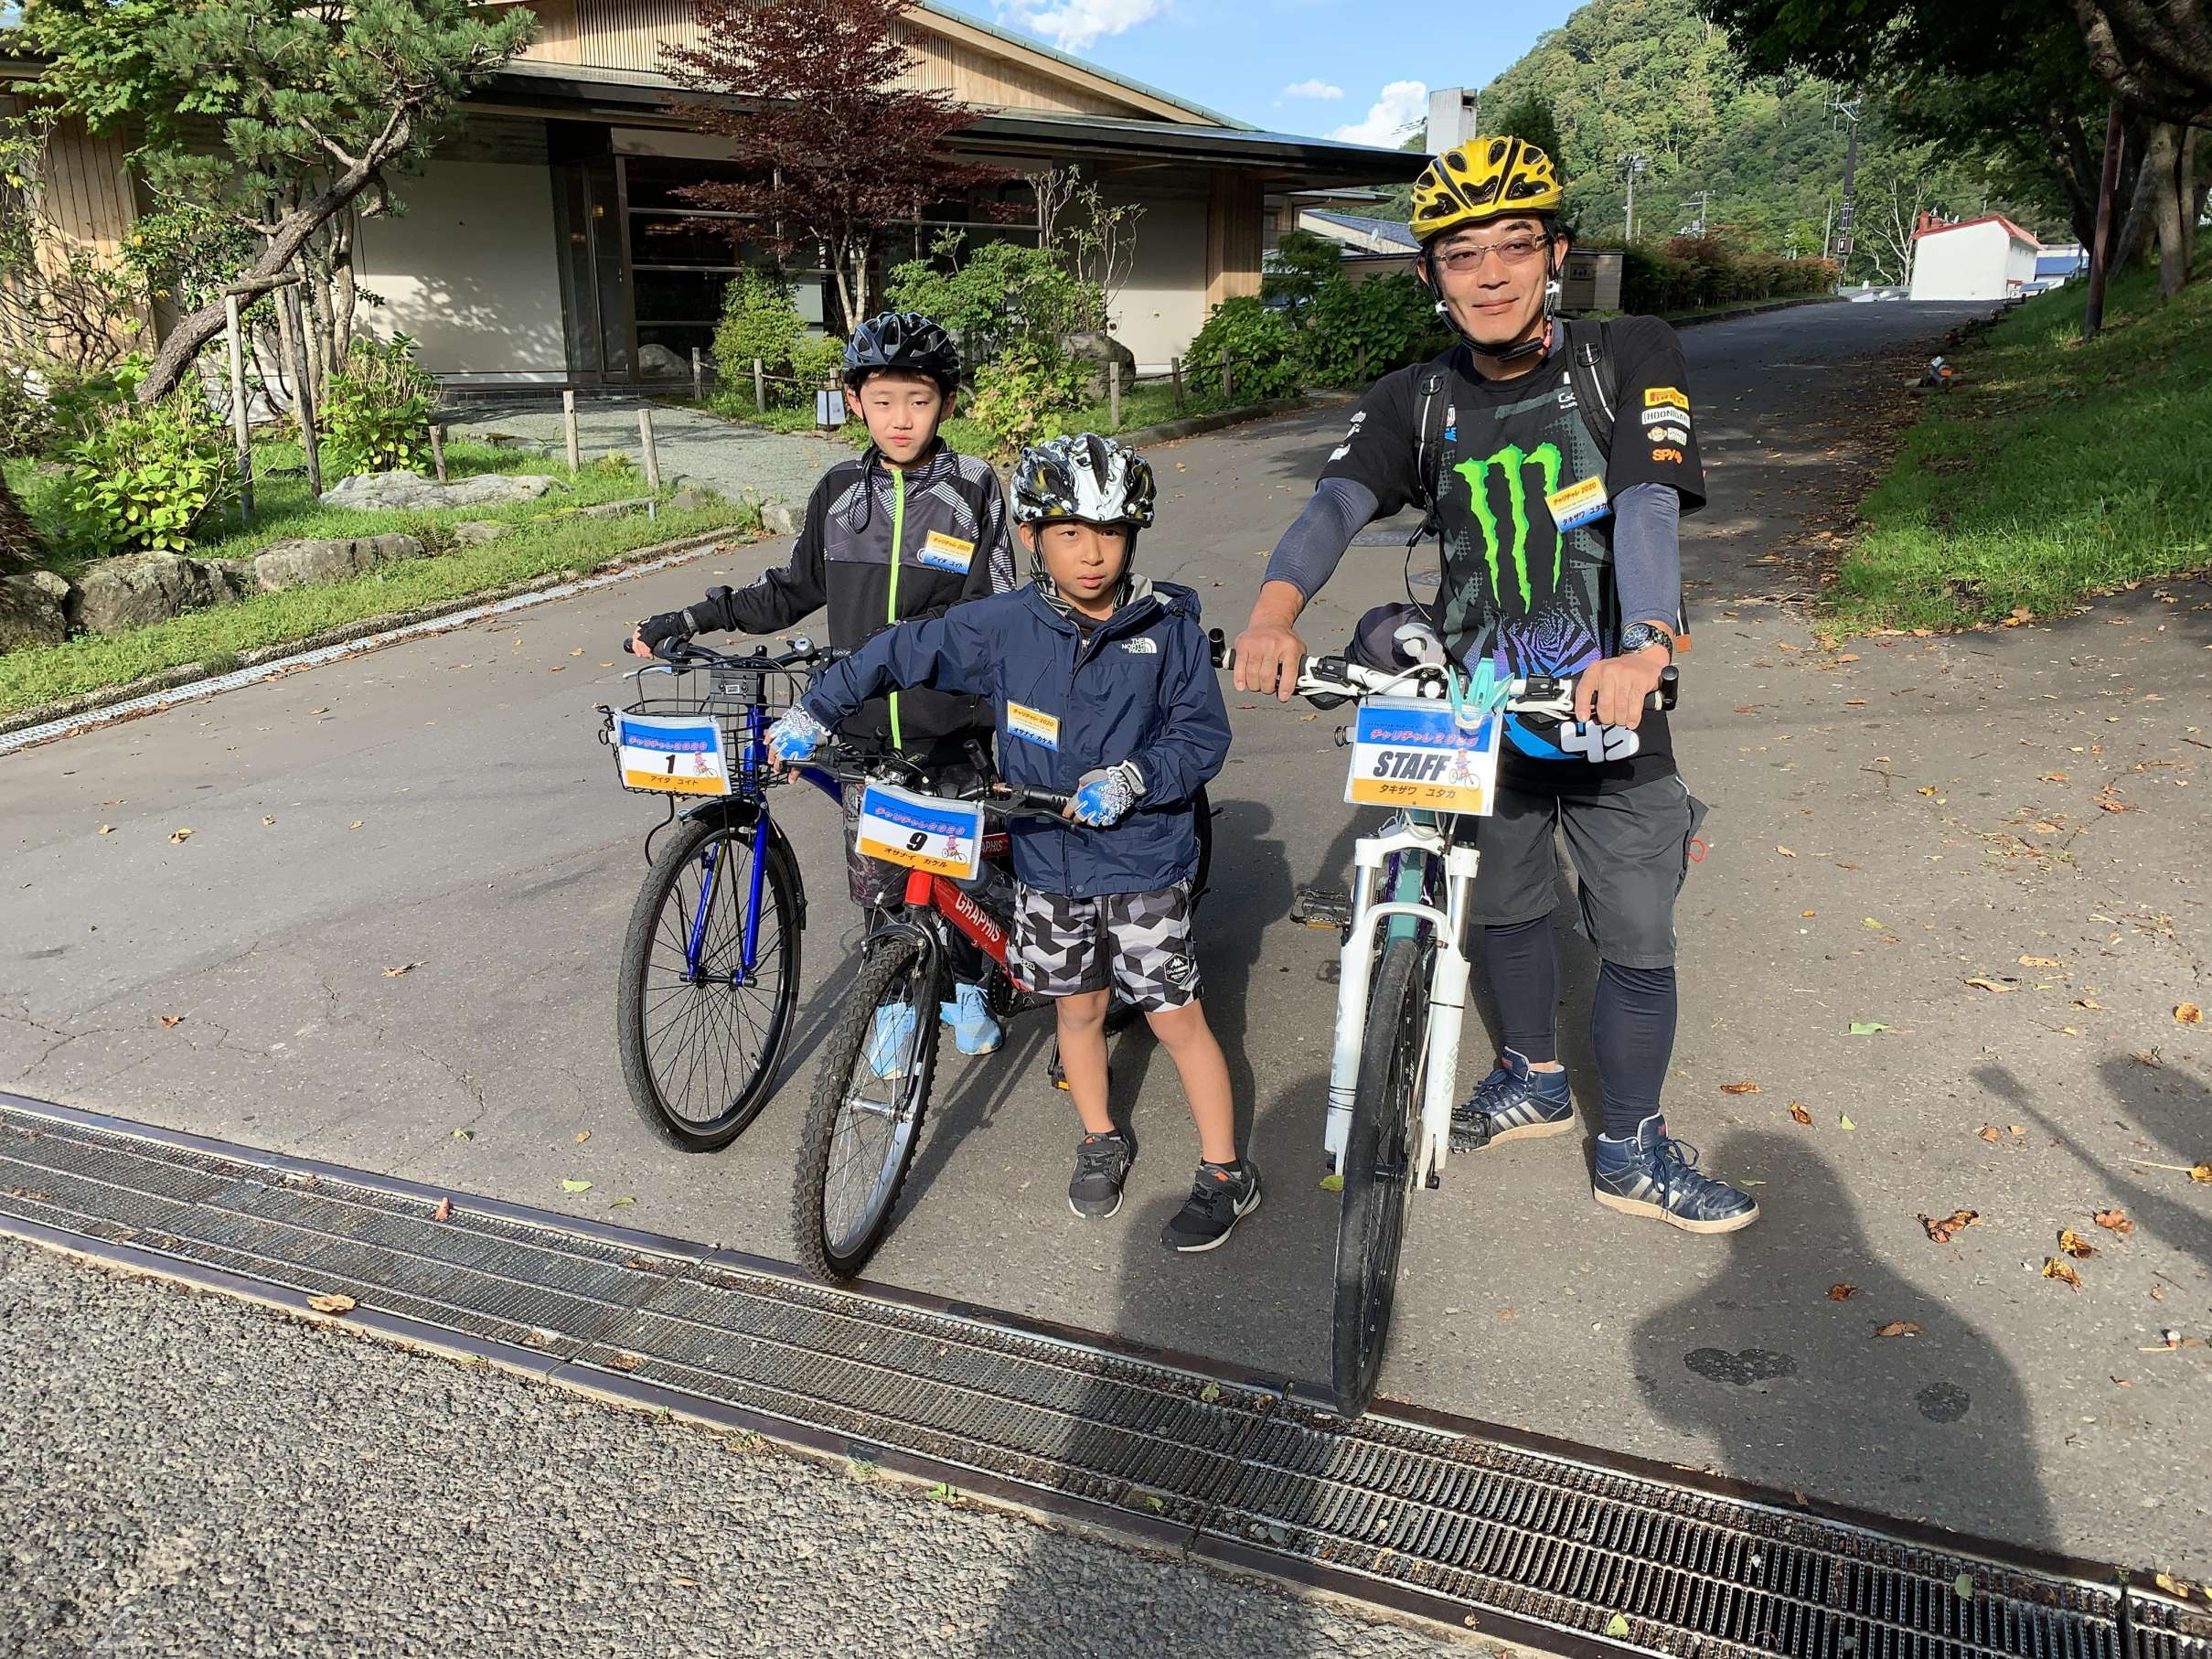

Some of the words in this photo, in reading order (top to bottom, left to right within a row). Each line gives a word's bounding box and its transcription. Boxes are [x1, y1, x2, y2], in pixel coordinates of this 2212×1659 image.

[665, 754, 676, 774] 1
[1373, 751, 1453, 781] STAFF
[906, 831, 928, 851] 9
[955, 891, 1002, 942] GRAPHIS
